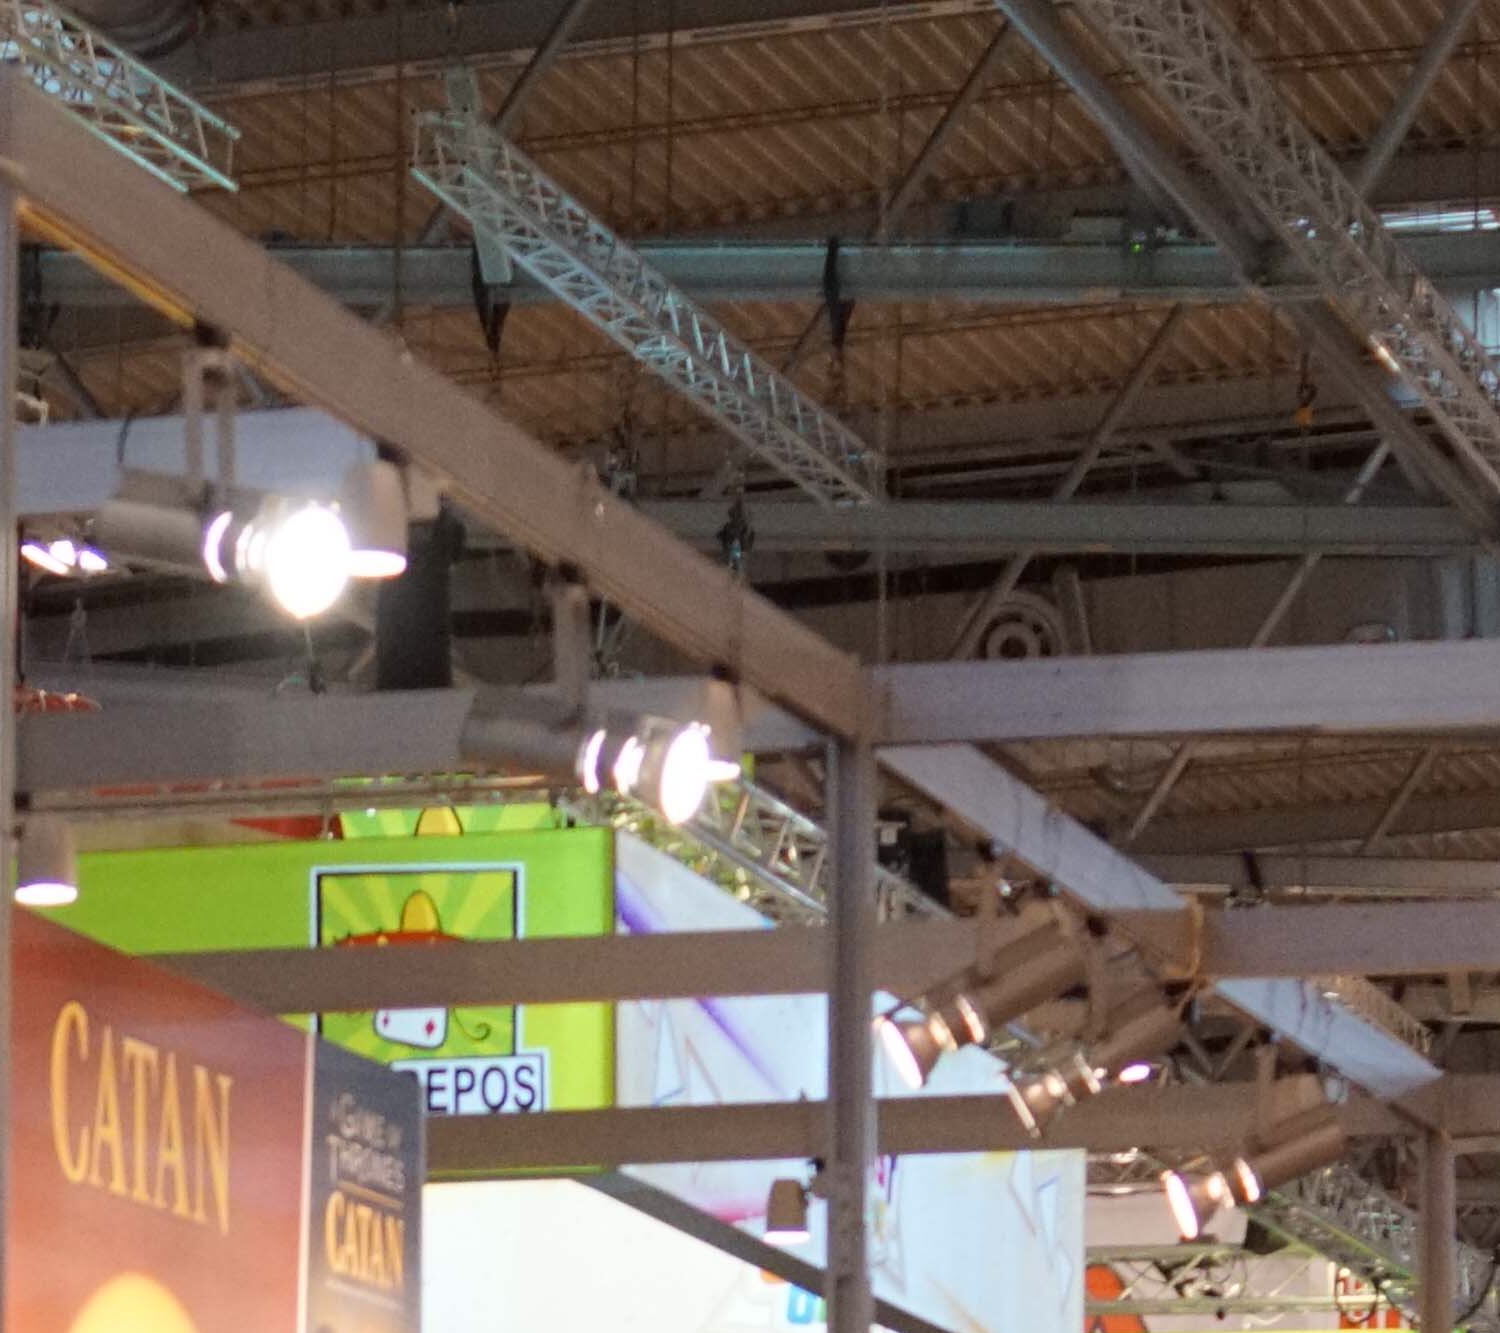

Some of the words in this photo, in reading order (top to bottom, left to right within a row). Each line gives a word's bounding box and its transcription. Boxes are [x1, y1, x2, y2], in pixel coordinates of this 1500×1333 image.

[51, 1000, 236, 1236] CATAN
[426, 1064, 537, 1113] EPOS
[325, 1189, 405, 1290] CATAN
